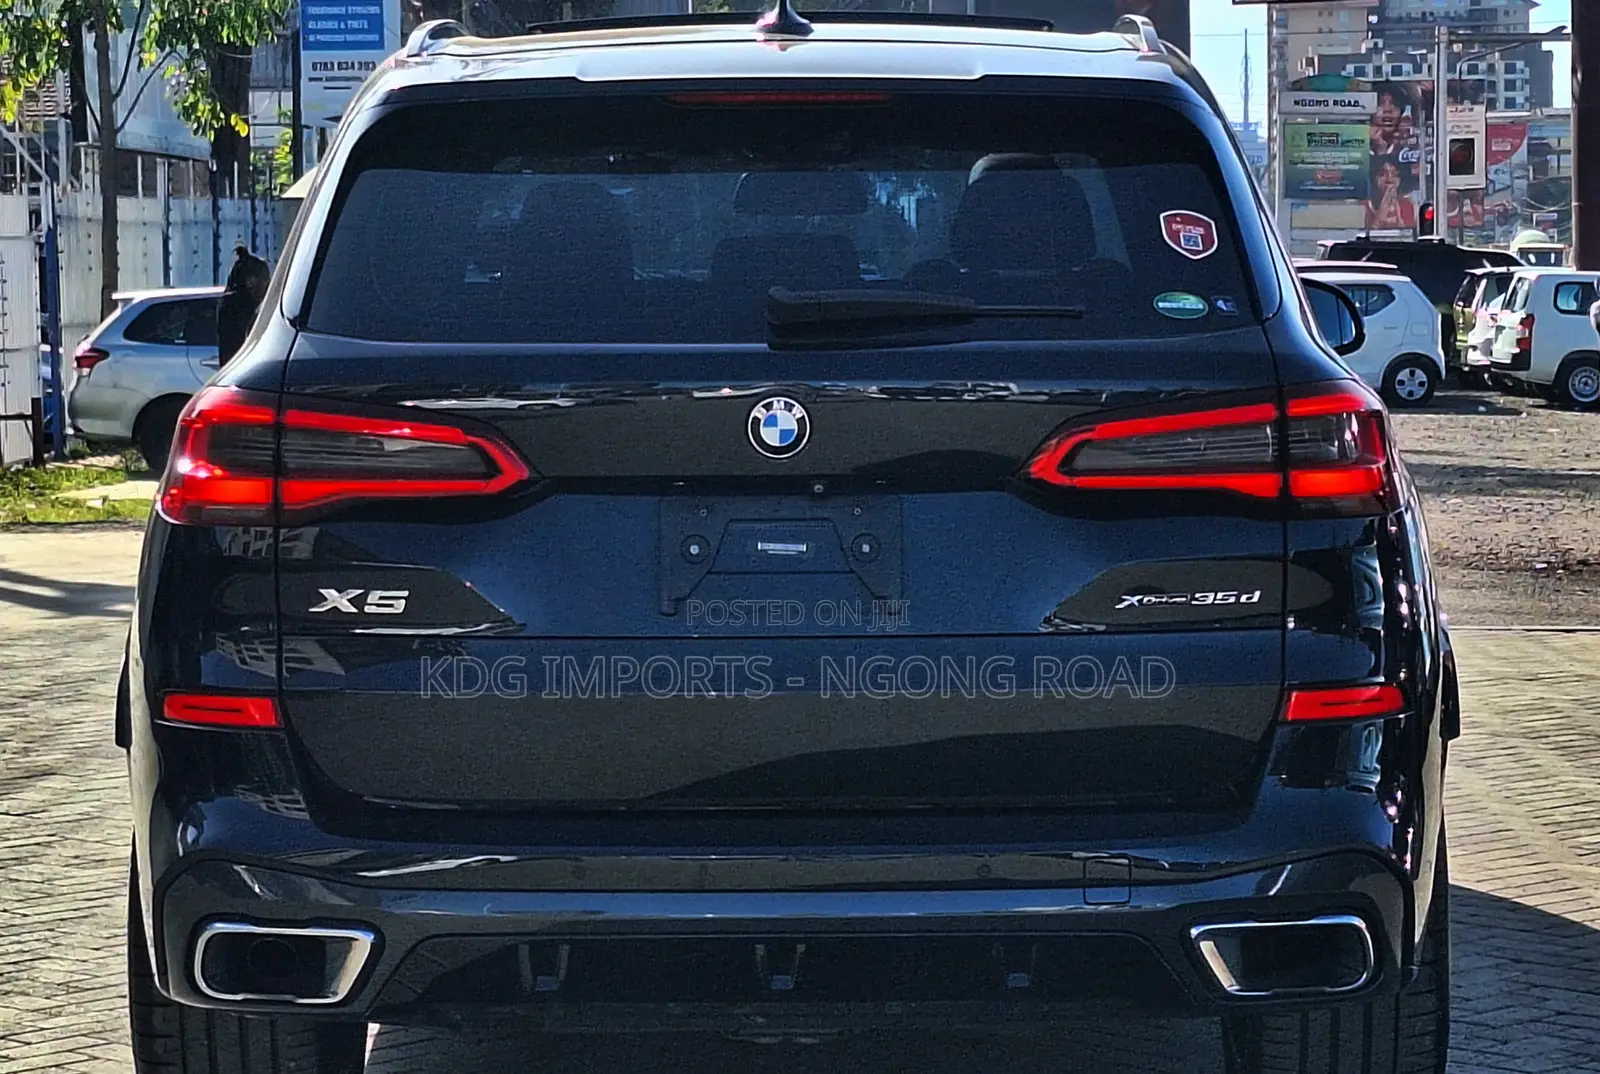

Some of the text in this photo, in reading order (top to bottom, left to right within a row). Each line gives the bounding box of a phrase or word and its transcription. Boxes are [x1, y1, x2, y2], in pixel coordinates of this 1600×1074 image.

[1293, 99, 1360, 108] NGONG ROAD
[751, 399, 805, 420] BMW
[308, 588, 410, 614] X5
